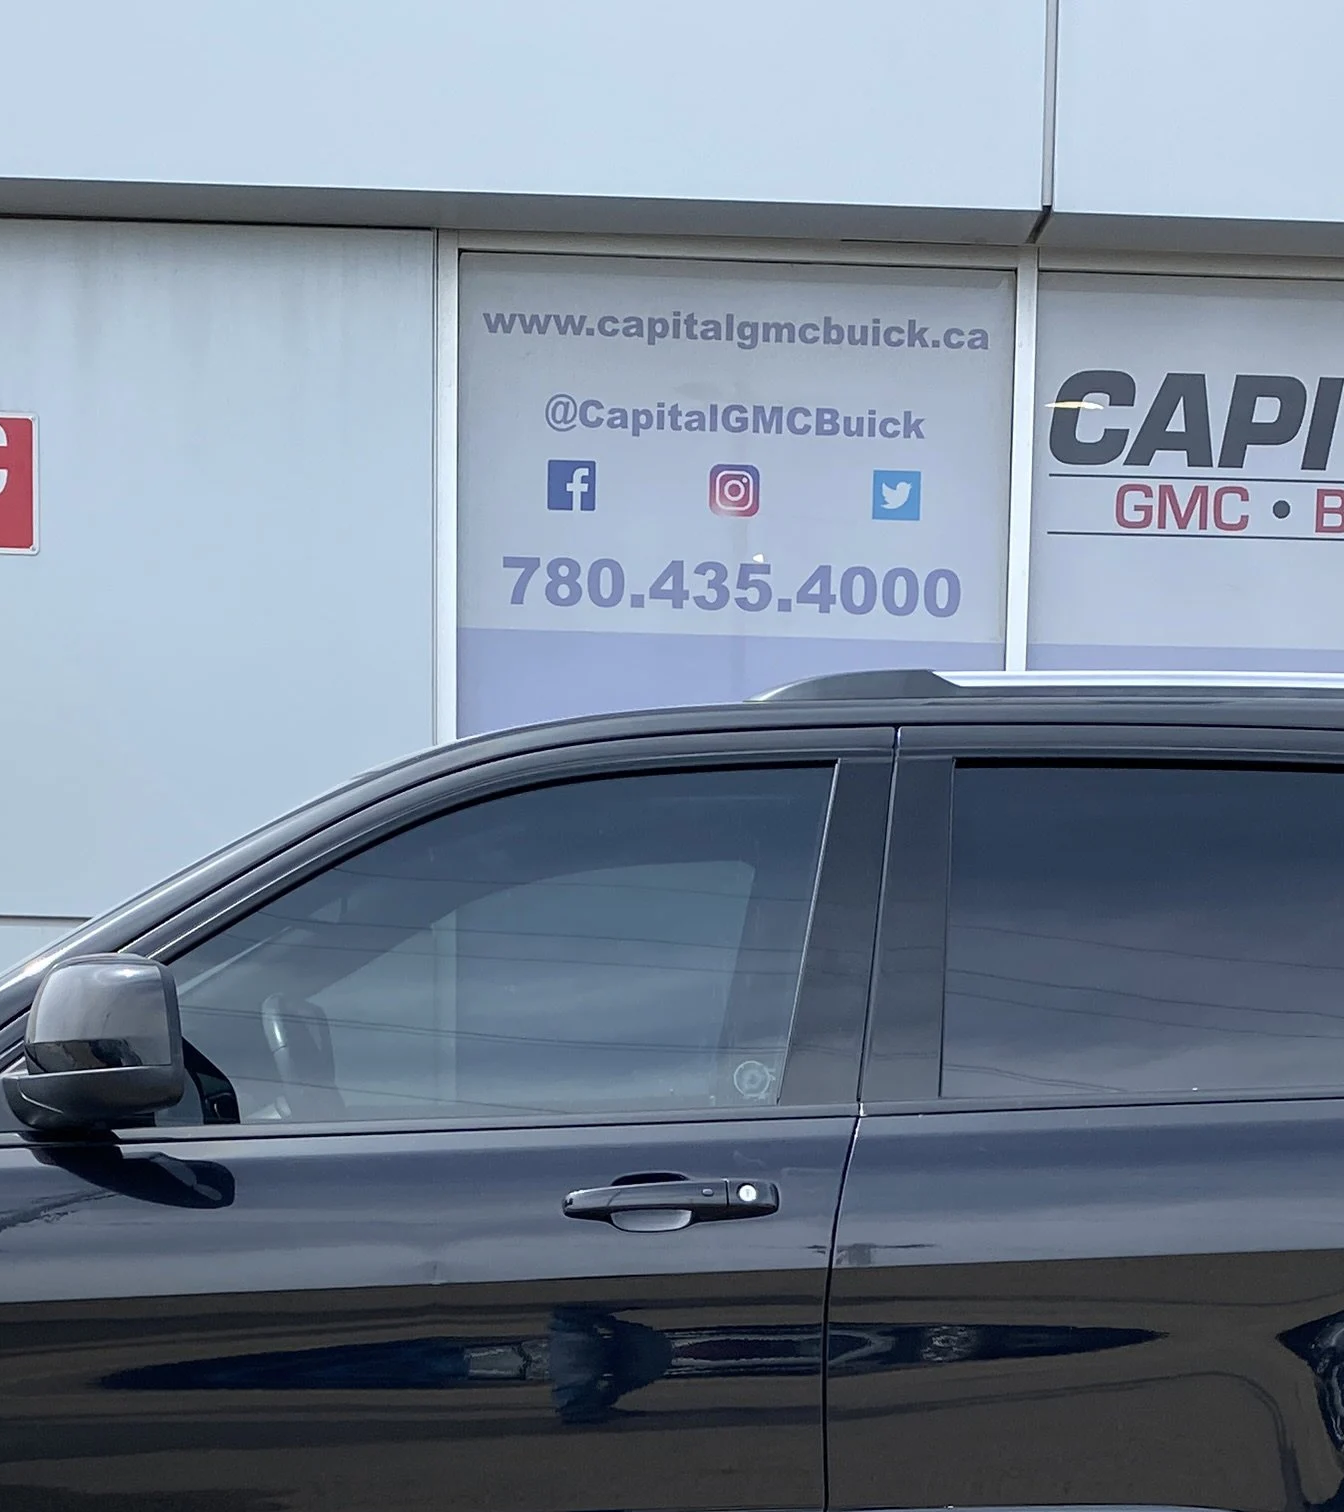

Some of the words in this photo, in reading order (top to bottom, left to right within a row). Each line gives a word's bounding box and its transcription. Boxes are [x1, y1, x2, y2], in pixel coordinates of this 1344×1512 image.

[483, 310, 990, 351] www.capitalgmcbuick.ca
[544, 393, 925, 440] @CapitalGMCBuick
[1114, 483, 1250, 532] GMC
[501, 555, 961, 619] 780.435.4000
